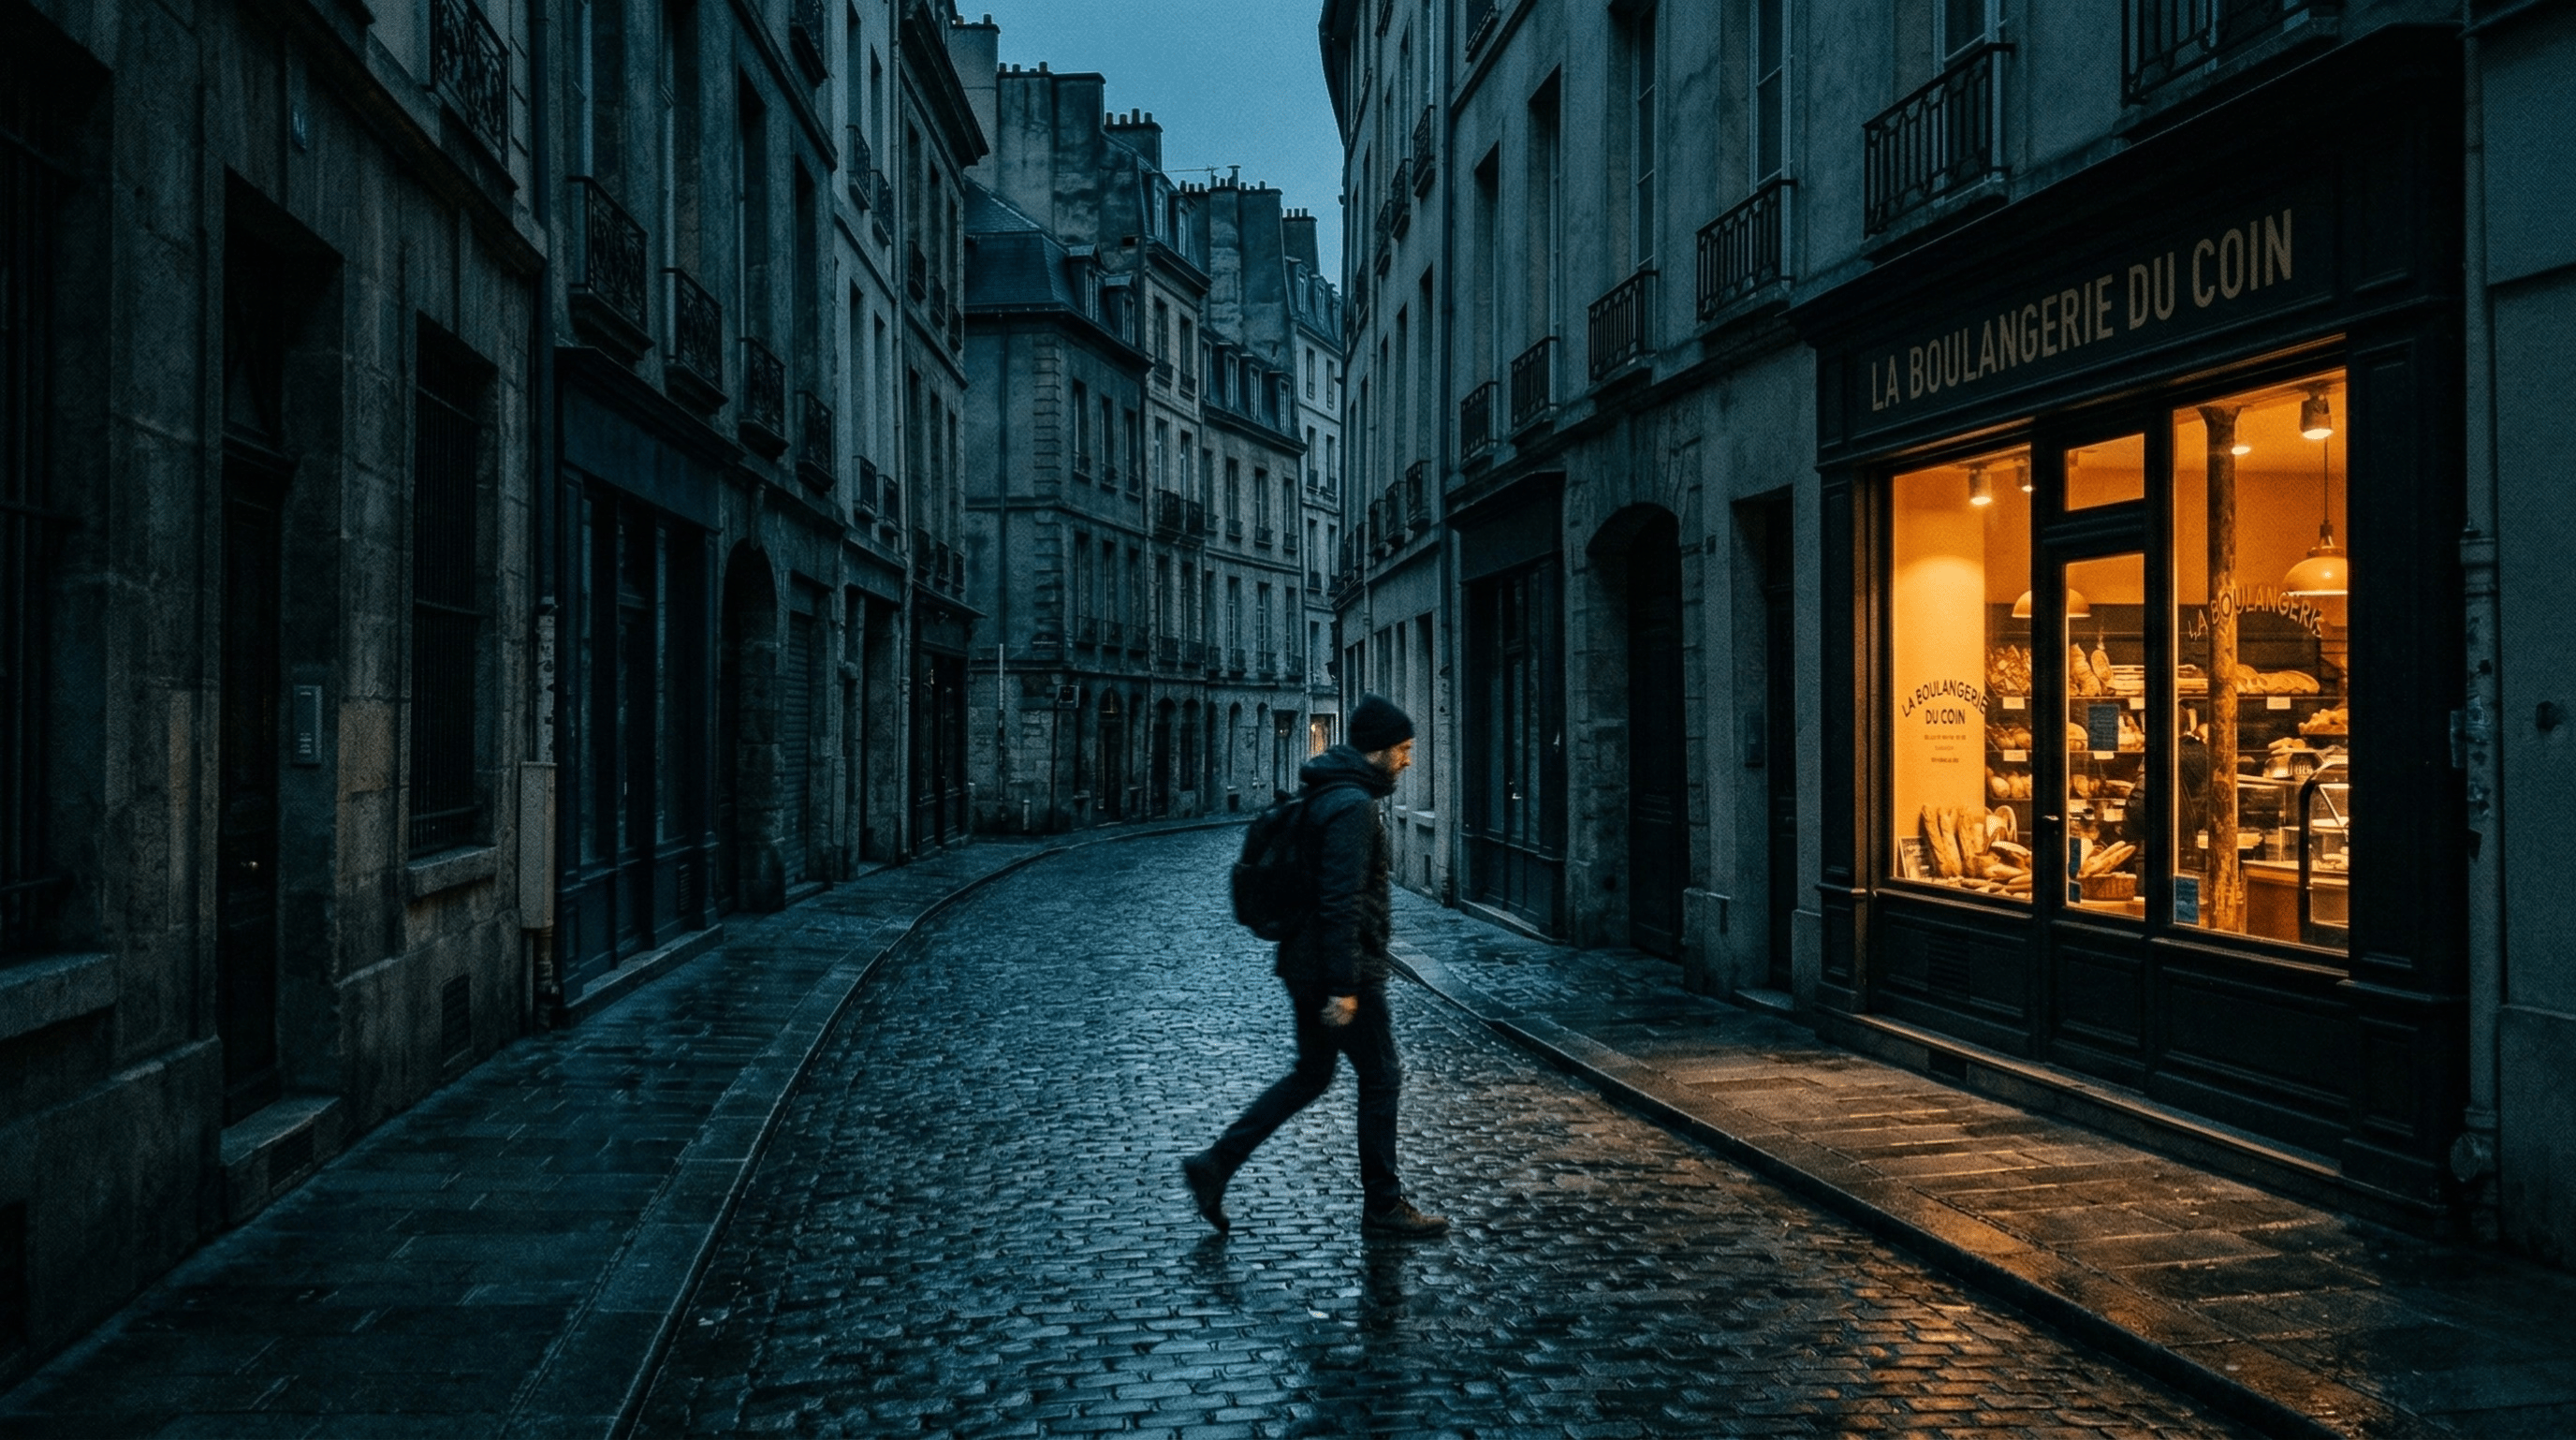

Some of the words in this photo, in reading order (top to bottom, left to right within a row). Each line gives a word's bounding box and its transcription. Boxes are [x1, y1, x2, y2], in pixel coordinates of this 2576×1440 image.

[1872, 354, 1900, 412] LA
[1910, 273, 2115, 401] BOULANGERIE
[2129, 251, 2175, 331] DU
[2192, 208, 2292, 309] COIN
[1902, 696, 1916, 718] LA
[1915, 679, 1991, 715] BOULANGERIE
[1925, 708, 1939, 725] DU
[1940, 708, 1966, 725] COIN
